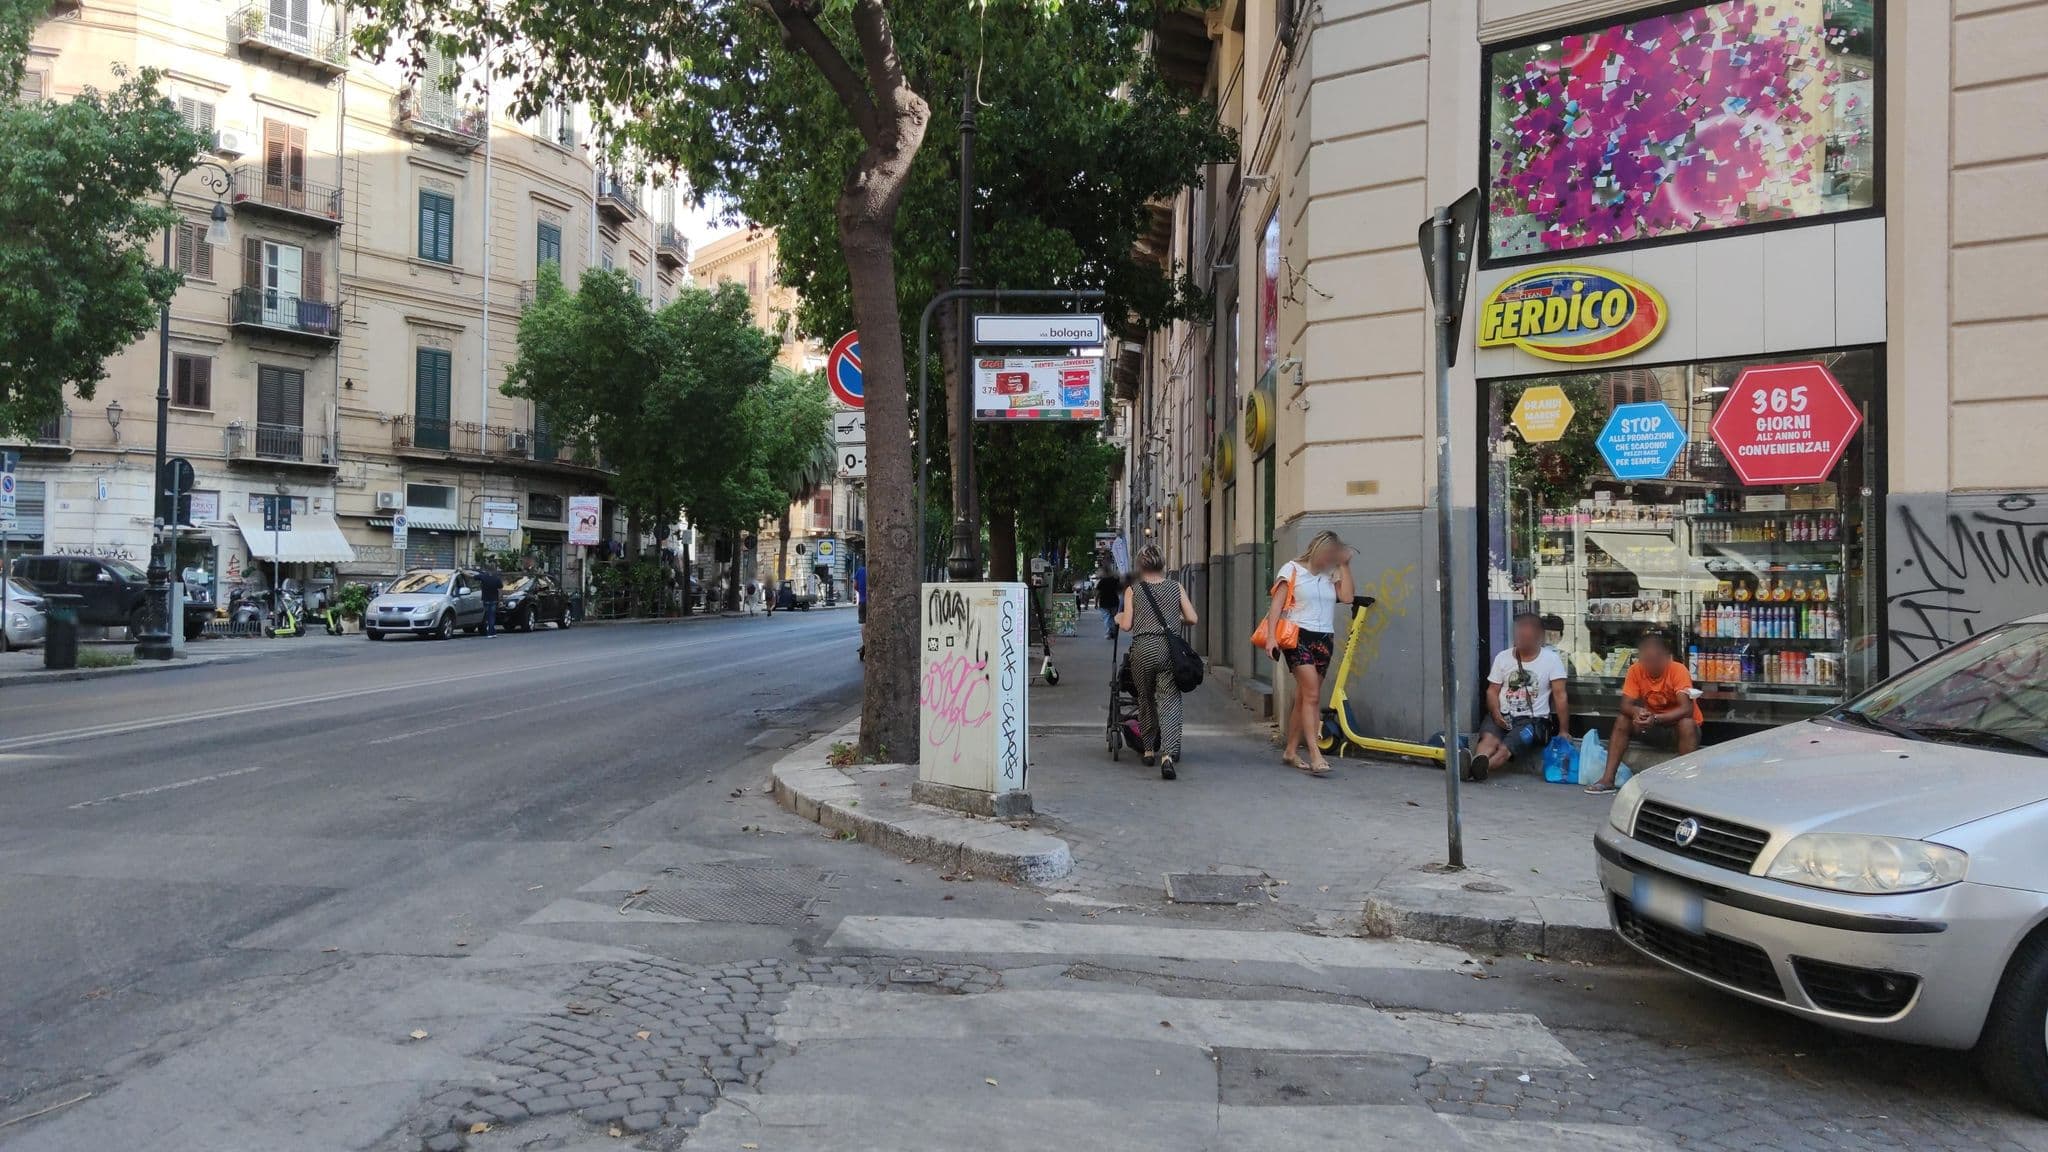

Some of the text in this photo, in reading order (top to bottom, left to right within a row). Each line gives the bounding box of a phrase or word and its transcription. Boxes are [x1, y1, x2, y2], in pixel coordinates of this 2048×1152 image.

[1050, 328, 1093, 339] bologna
[1751, 386, 1808, 414] 365
[1621, 416, 1661, 433] STOP
[1756, 415, 1811, 431] GIORNI
[1627, 432, 1674, 442] PROMOZIONI
[1775, 430, 1799, 440] ANNO
[1802, 430, 1812, 439] DI
[1615, 443, 1630, 451] CHE
[1738, 441, 1830, 456] CONVENIENZA!!
[1616, 458, 1630, 466] PER
